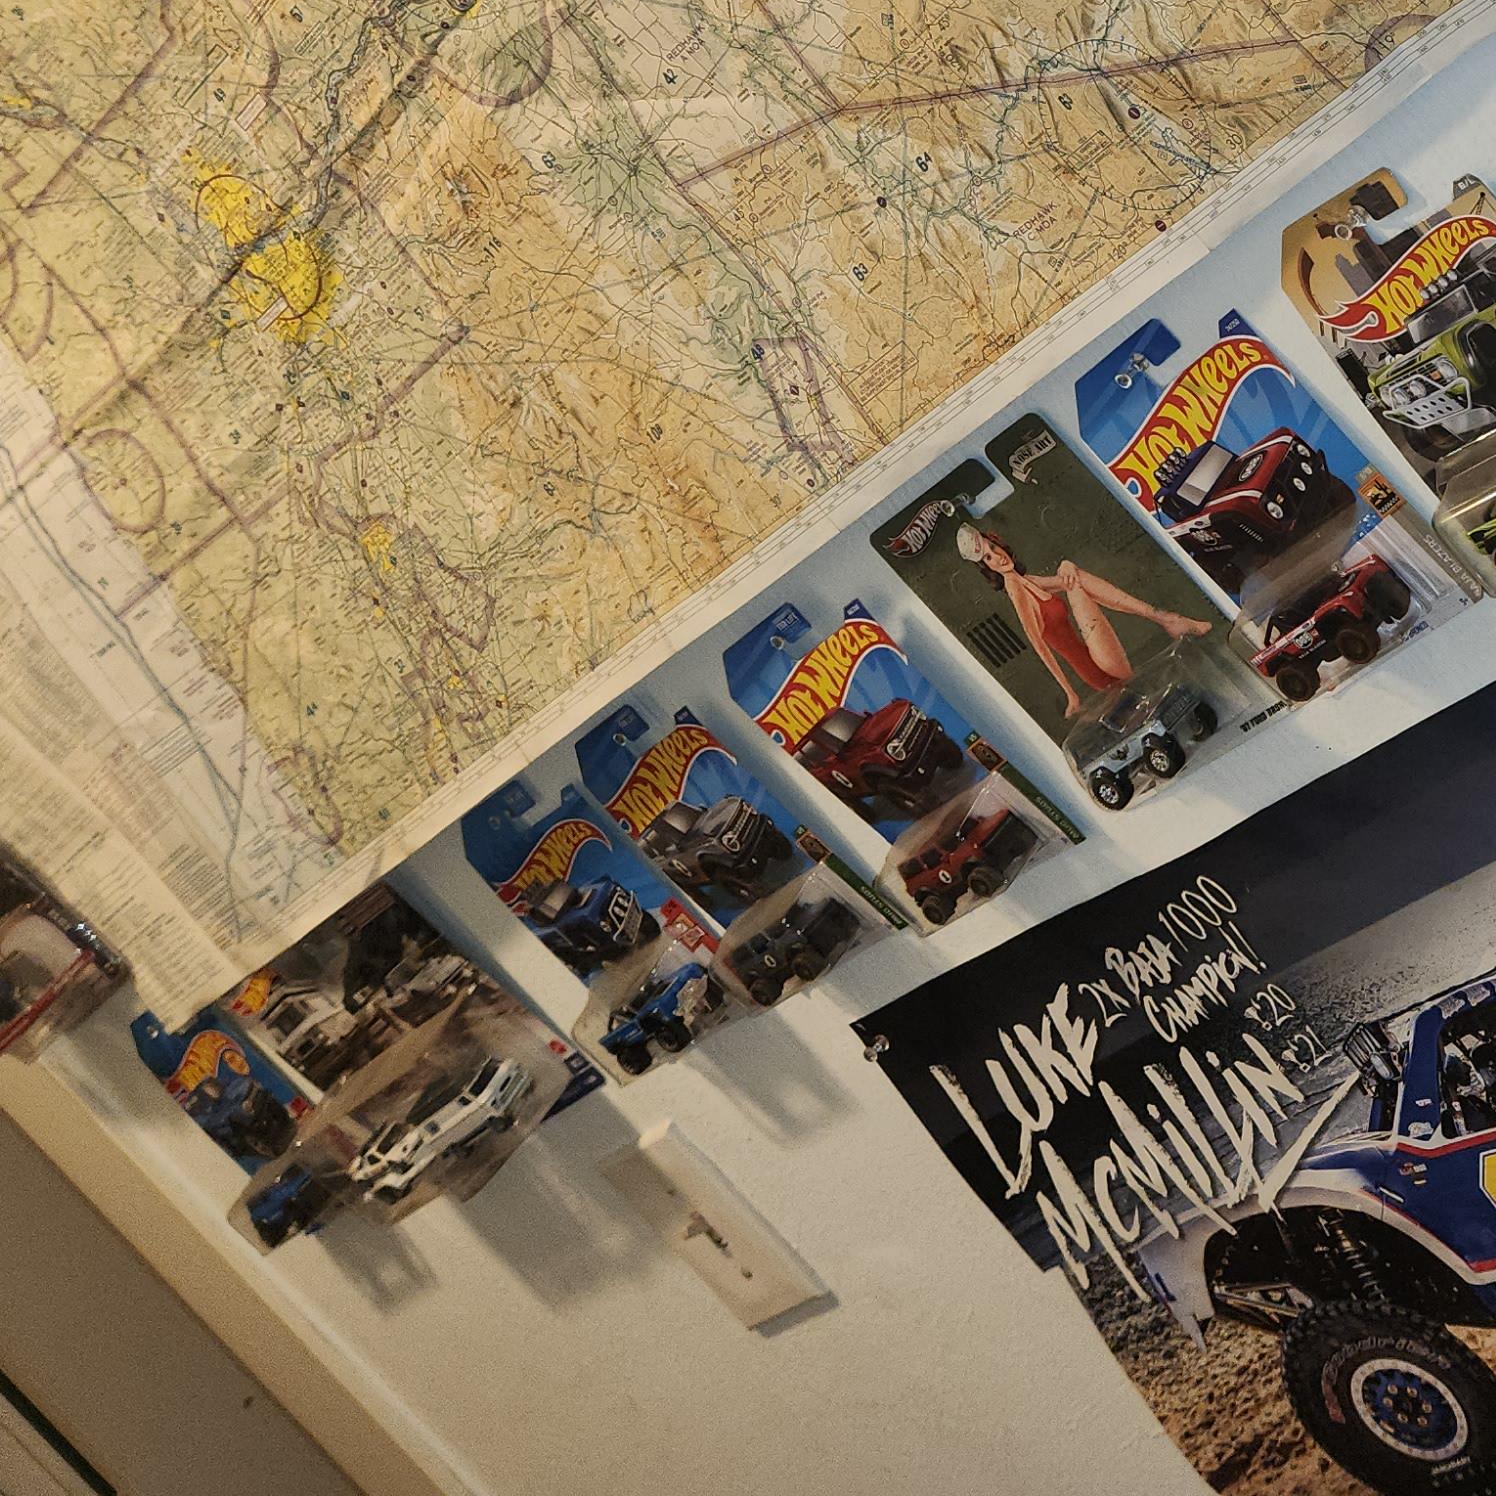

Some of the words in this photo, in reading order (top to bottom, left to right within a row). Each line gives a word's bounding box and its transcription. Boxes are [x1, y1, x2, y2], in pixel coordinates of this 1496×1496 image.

[1105, 933, 1182, 1001] BAJA
[1157, 875, 1238, 953] 1000
[929, 981, 1098, 1200] LUKE
